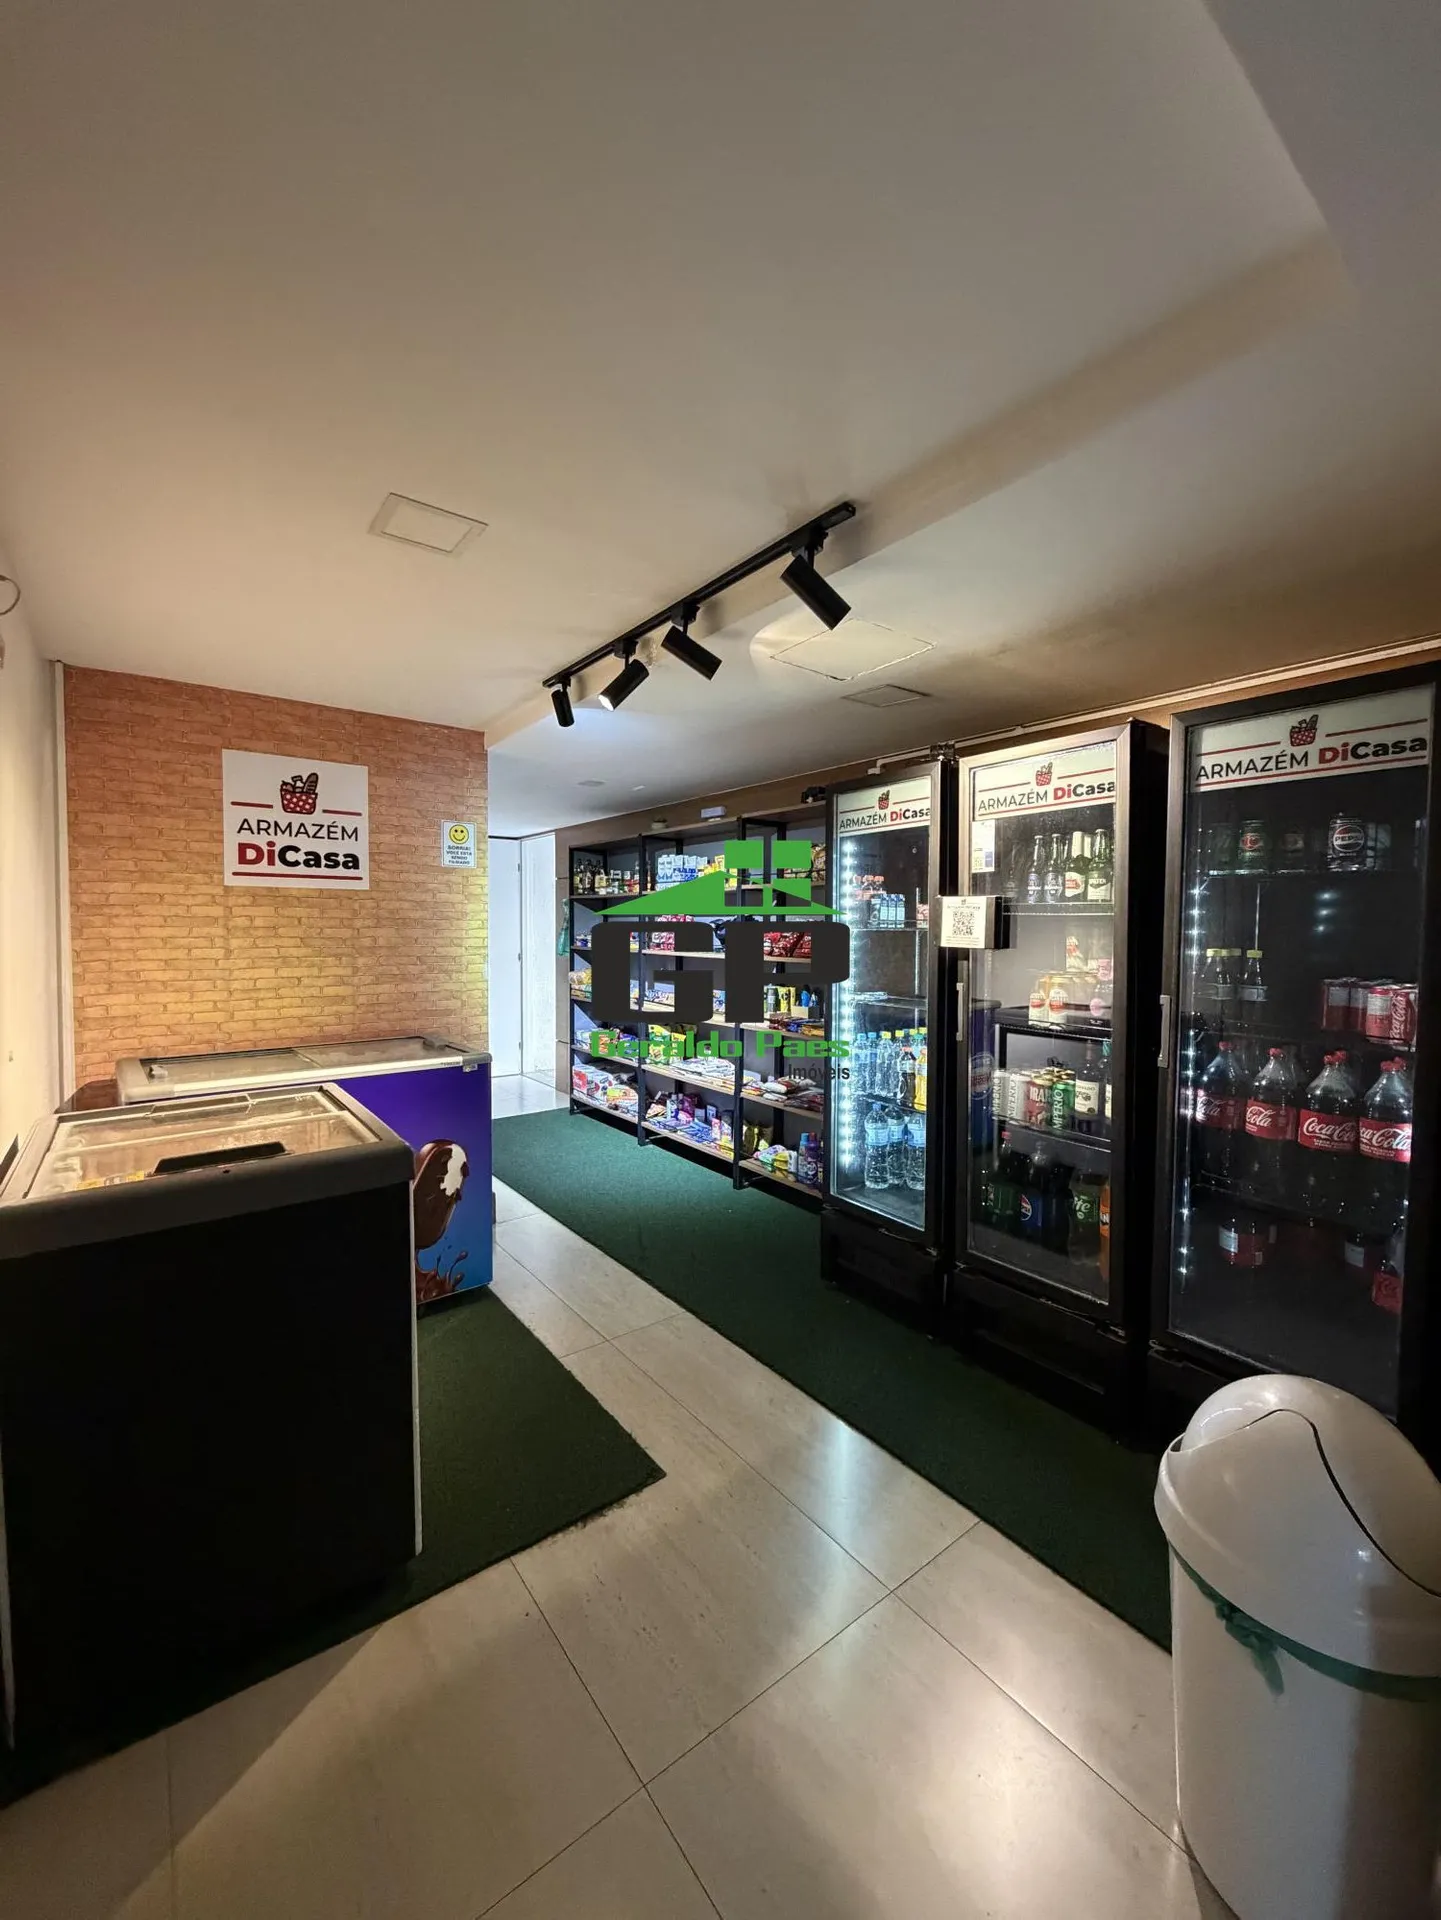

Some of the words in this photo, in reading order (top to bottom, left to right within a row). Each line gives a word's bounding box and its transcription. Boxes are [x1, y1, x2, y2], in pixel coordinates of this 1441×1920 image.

[1195, 750, 1309, 782] ARMAZÉM
[1318, 737, 1428, 765] DiCasa
[978, 788, 1048, 812] ARMAZÉM
[1053, 780, 1115, 801] DiCasa
[237, 817, 359, 842] ARMAZÉM
[839, 811, 887, 830] ARMAZÉM
[237, 840, 360, 870] DiCasa
[1303, 1117, 1356, 1141] Coca-Co
